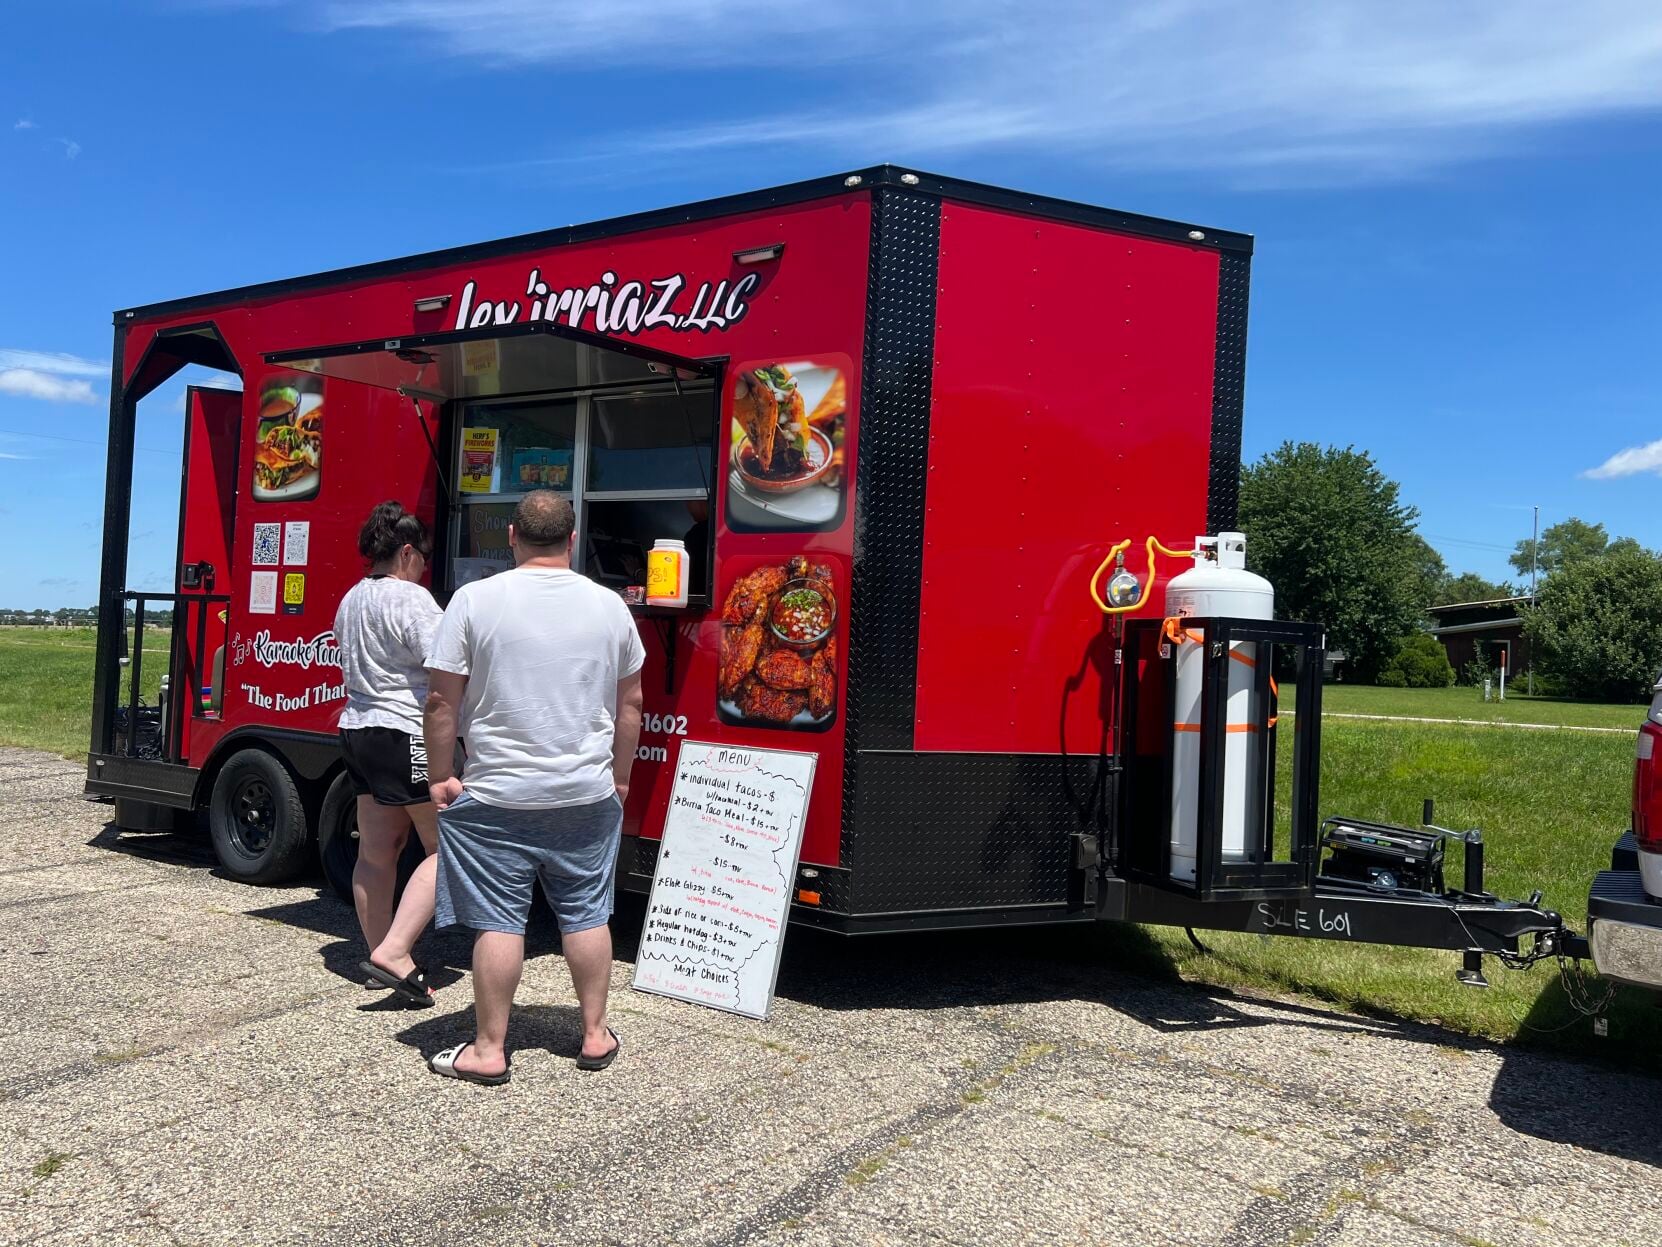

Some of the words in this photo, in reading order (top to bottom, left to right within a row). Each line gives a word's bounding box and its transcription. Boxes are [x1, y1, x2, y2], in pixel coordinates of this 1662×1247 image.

[253, 629, 314, 669] Karaoke
[275, 687, 310, 712] Food
[313, 681, 346, 705] That
[634, 745, 667, 762] om
[705, 802, 721, 816] Taco
[685, 910, 697, 920] rice
[656, 918, 682, 932] Regular
[654, 933, 677, 946] Drinks
[701, 968, 729, 984] Choices
